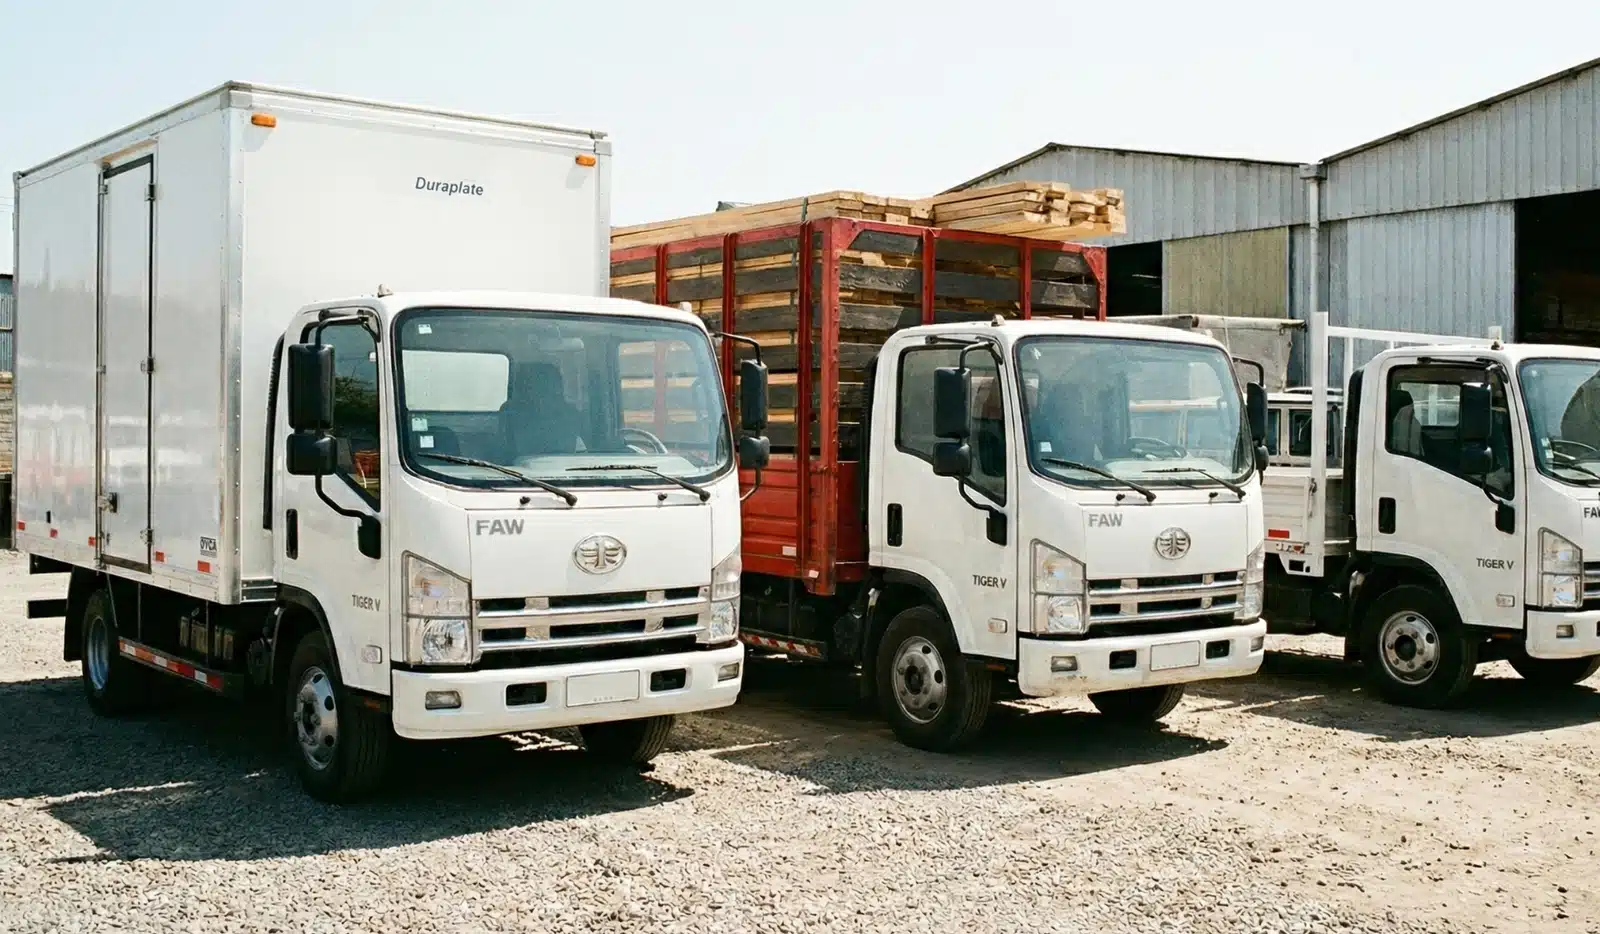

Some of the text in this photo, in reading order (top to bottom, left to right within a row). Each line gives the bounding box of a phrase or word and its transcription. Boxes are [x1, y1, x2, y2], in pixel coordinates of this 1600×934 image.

[415, 176, 484, 196] Duraplate
[1583, 506, 1600, 518] FA
[476, 518, 525, 536] FAW
[1088, 513, 1123, 528] FAW
[1476, 557, 1514, 570] TIGER V
[972, 574, 1007, 589] TIGER V
[351, 594, 381, 612] TIGER V
